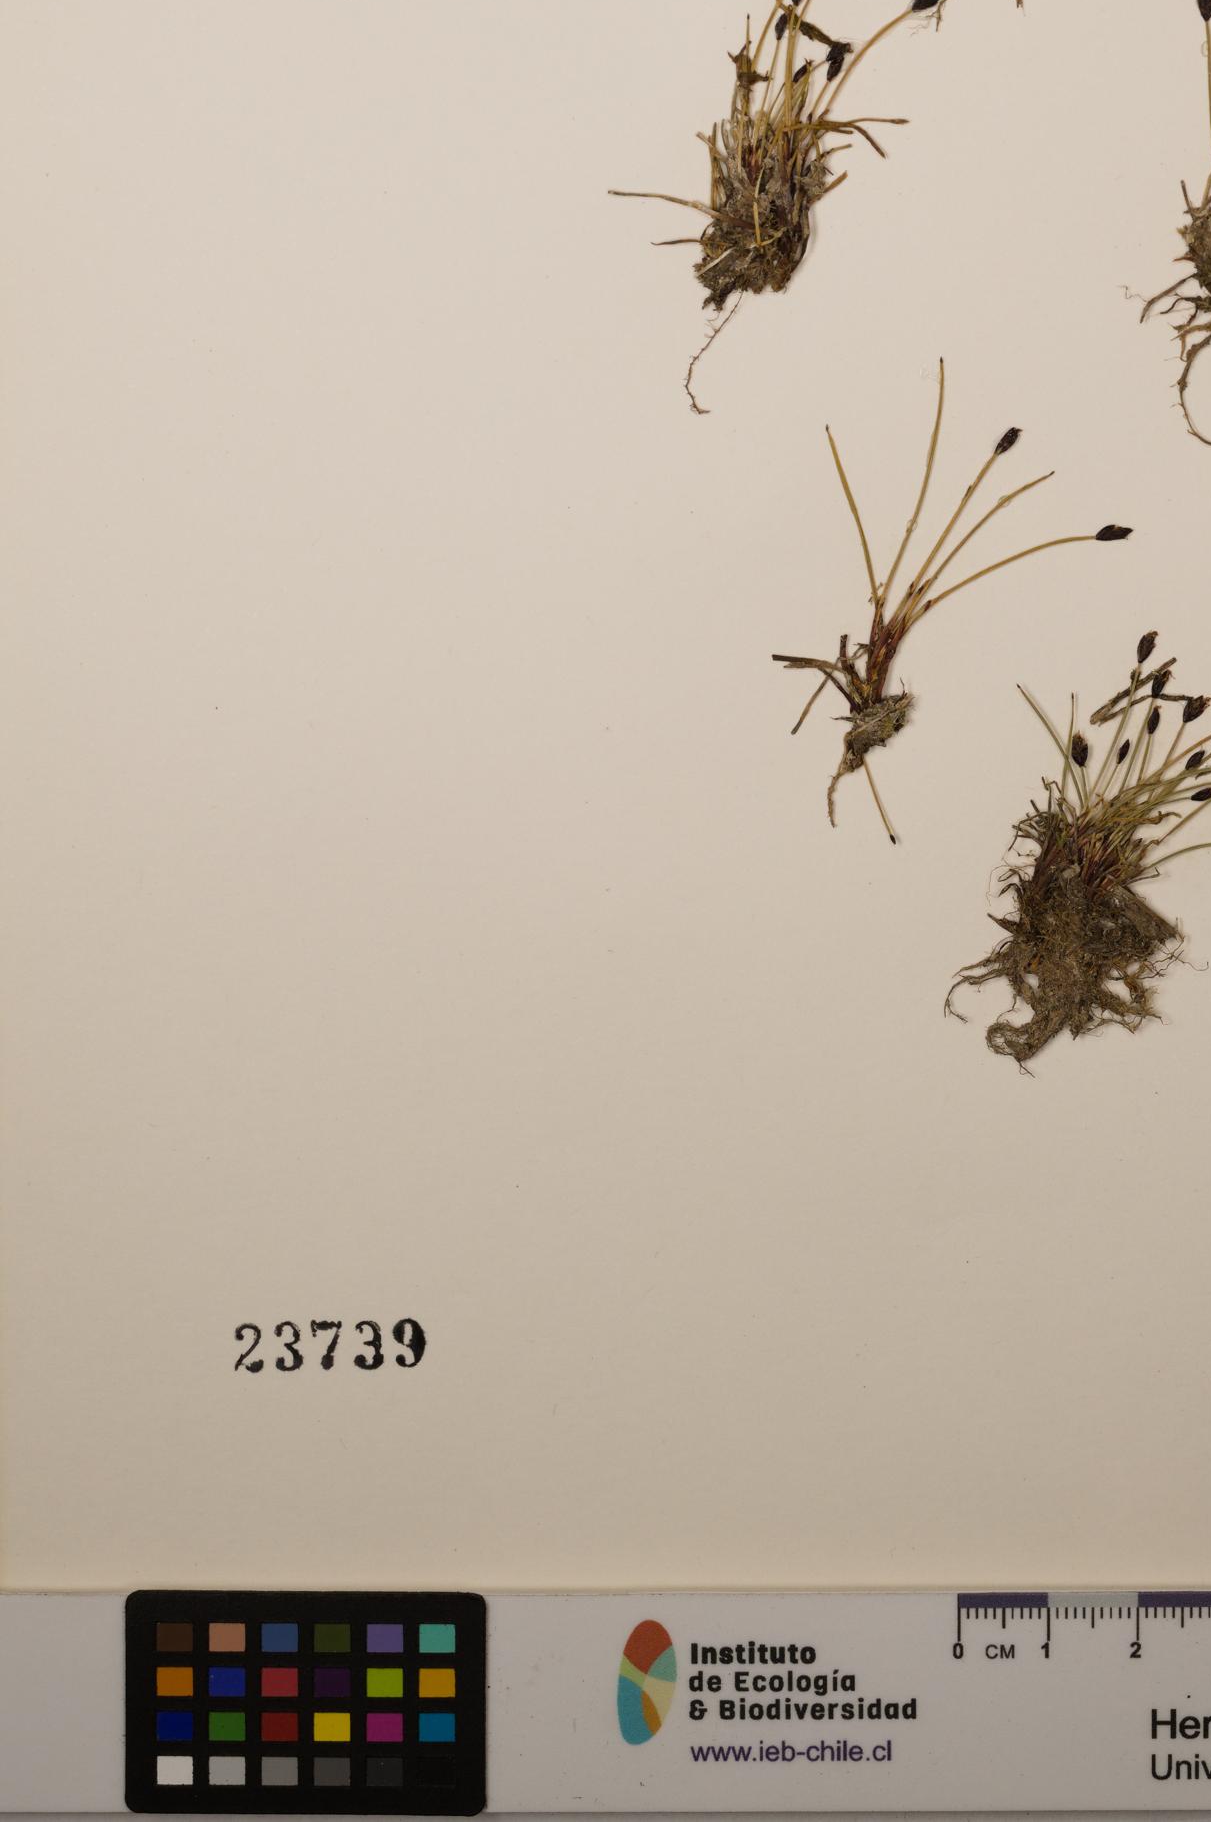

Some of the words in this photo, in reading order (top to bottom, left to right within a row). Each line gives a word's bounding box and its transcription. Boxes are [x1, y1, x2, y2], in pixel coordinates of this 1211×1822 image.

[234, 1318, 428, 1373] 23739
[690, 1641, 816, 1665] Instituto
[952, 1642, 964, 1659] 0
[985, 1644, 1015, 1660] CM
[1040, 1642, 1050, 1659] 1
[1129, 1642, 1141, 1659] 2
[689, 1670, 722, 1693] de
[734, 1669, 856, 1696] Ecología
[689, 1699, 708, 1721] &
[719, 1697, 917, 1720] Biodiversidad
[690, 1739, 892, 1763] www.ieb-chile.cl
